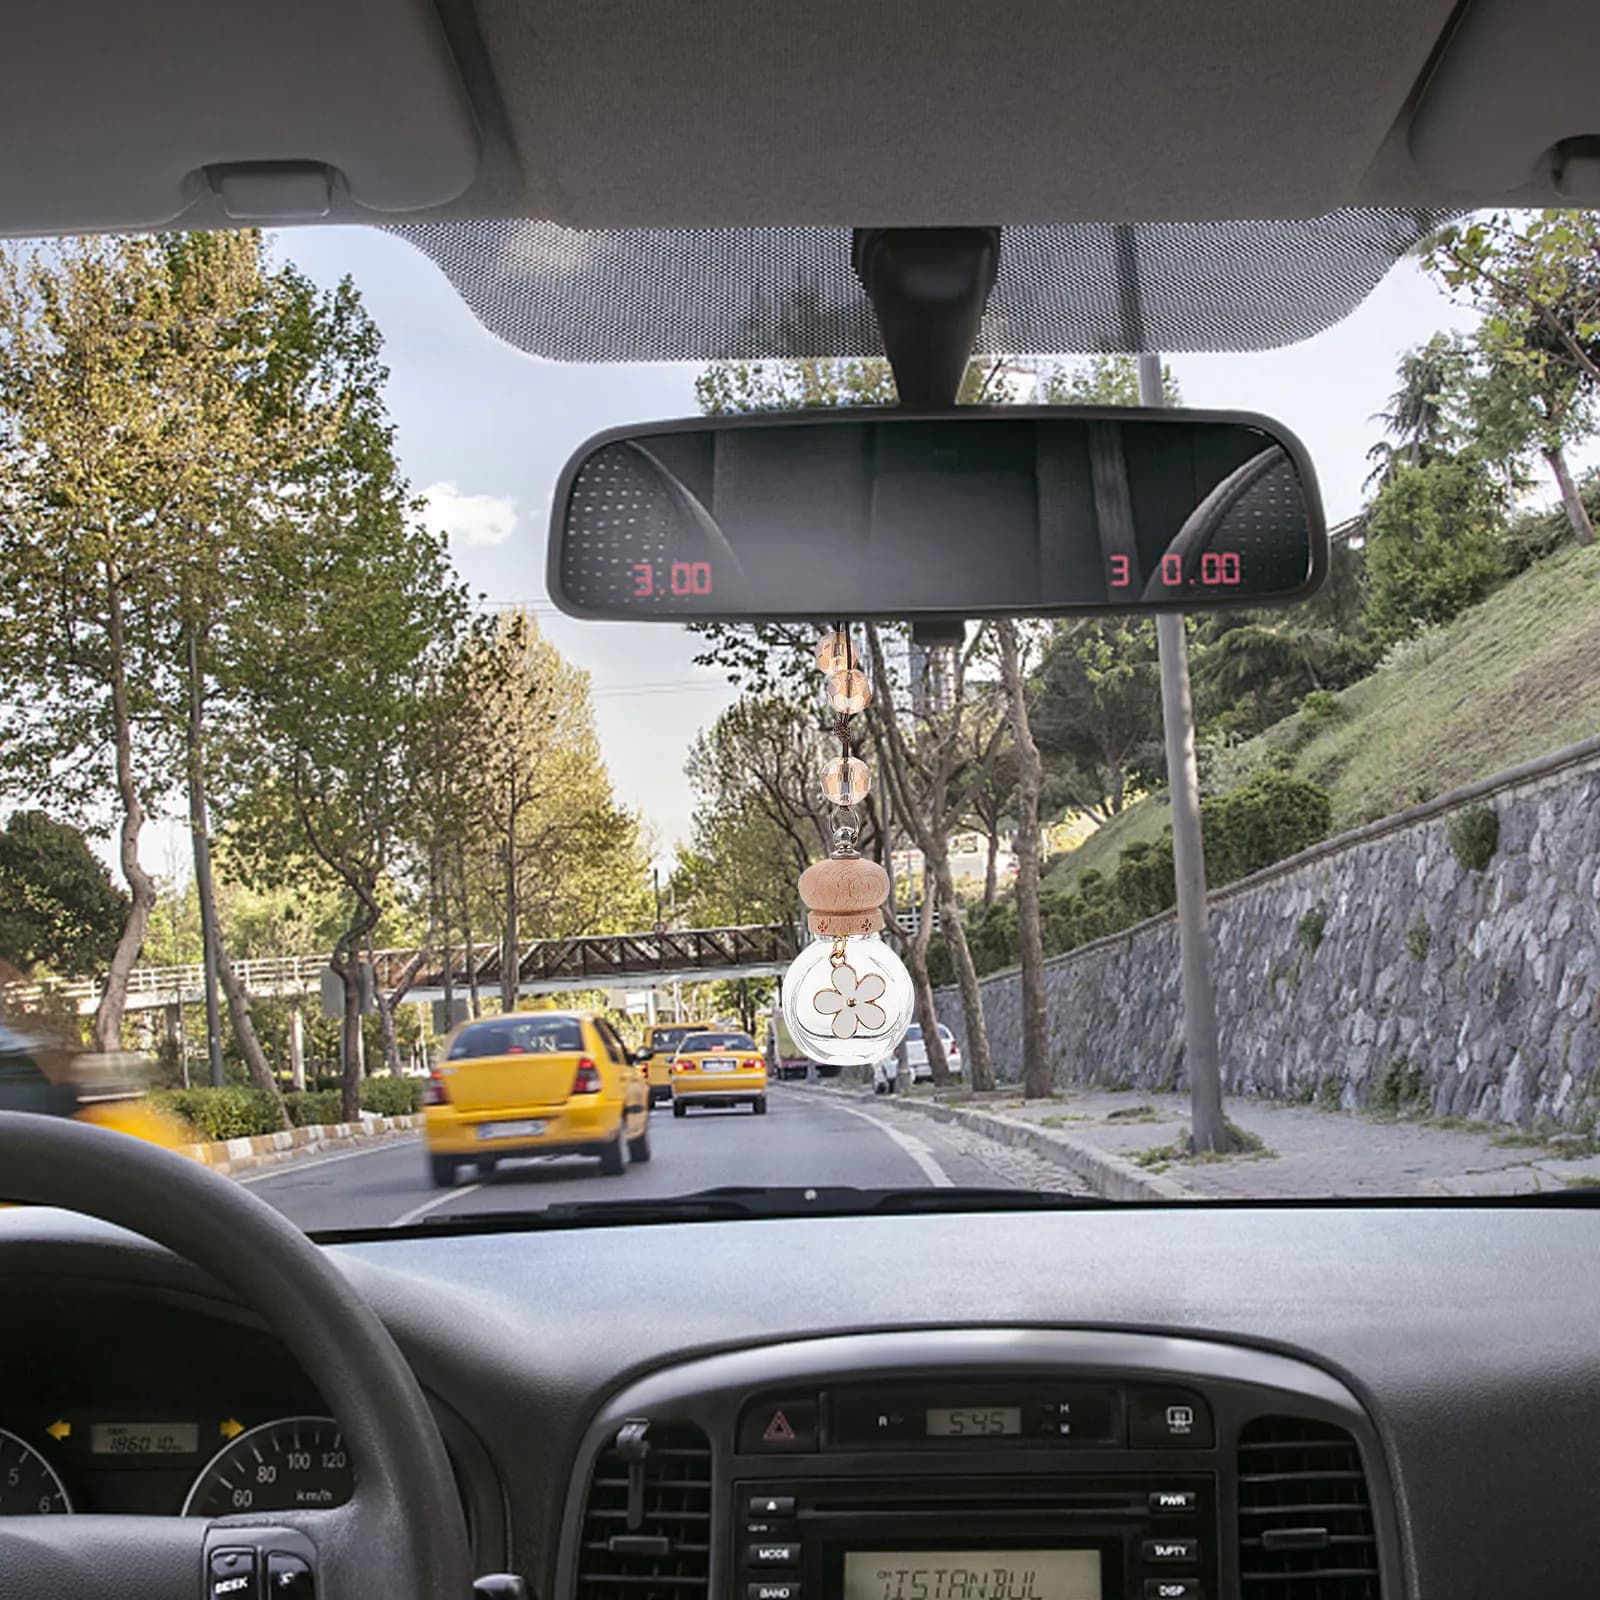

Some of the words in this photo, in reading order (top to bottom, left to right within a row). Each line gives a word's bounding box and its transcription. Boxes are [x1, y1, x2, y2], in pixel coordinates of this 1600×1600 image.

[632, 562, 712, 597] 3.00
[287, 1452, 311, 1470] 100
[321, 1451, 346, 1469] 120
[8, 1467, 20, 1487] 5
[256, 1465, 277, 1483] 80
[39, 1495, 50, 1513] 6
[232, 1489, 253, 1508] 60
[1159, 1495, 1186, 1506] PWR
[759, 1548, 789, 1560] MODE
[759, 1587, 791, 1599] BAND
[1158, 1584, 1186, 1597] DISP
